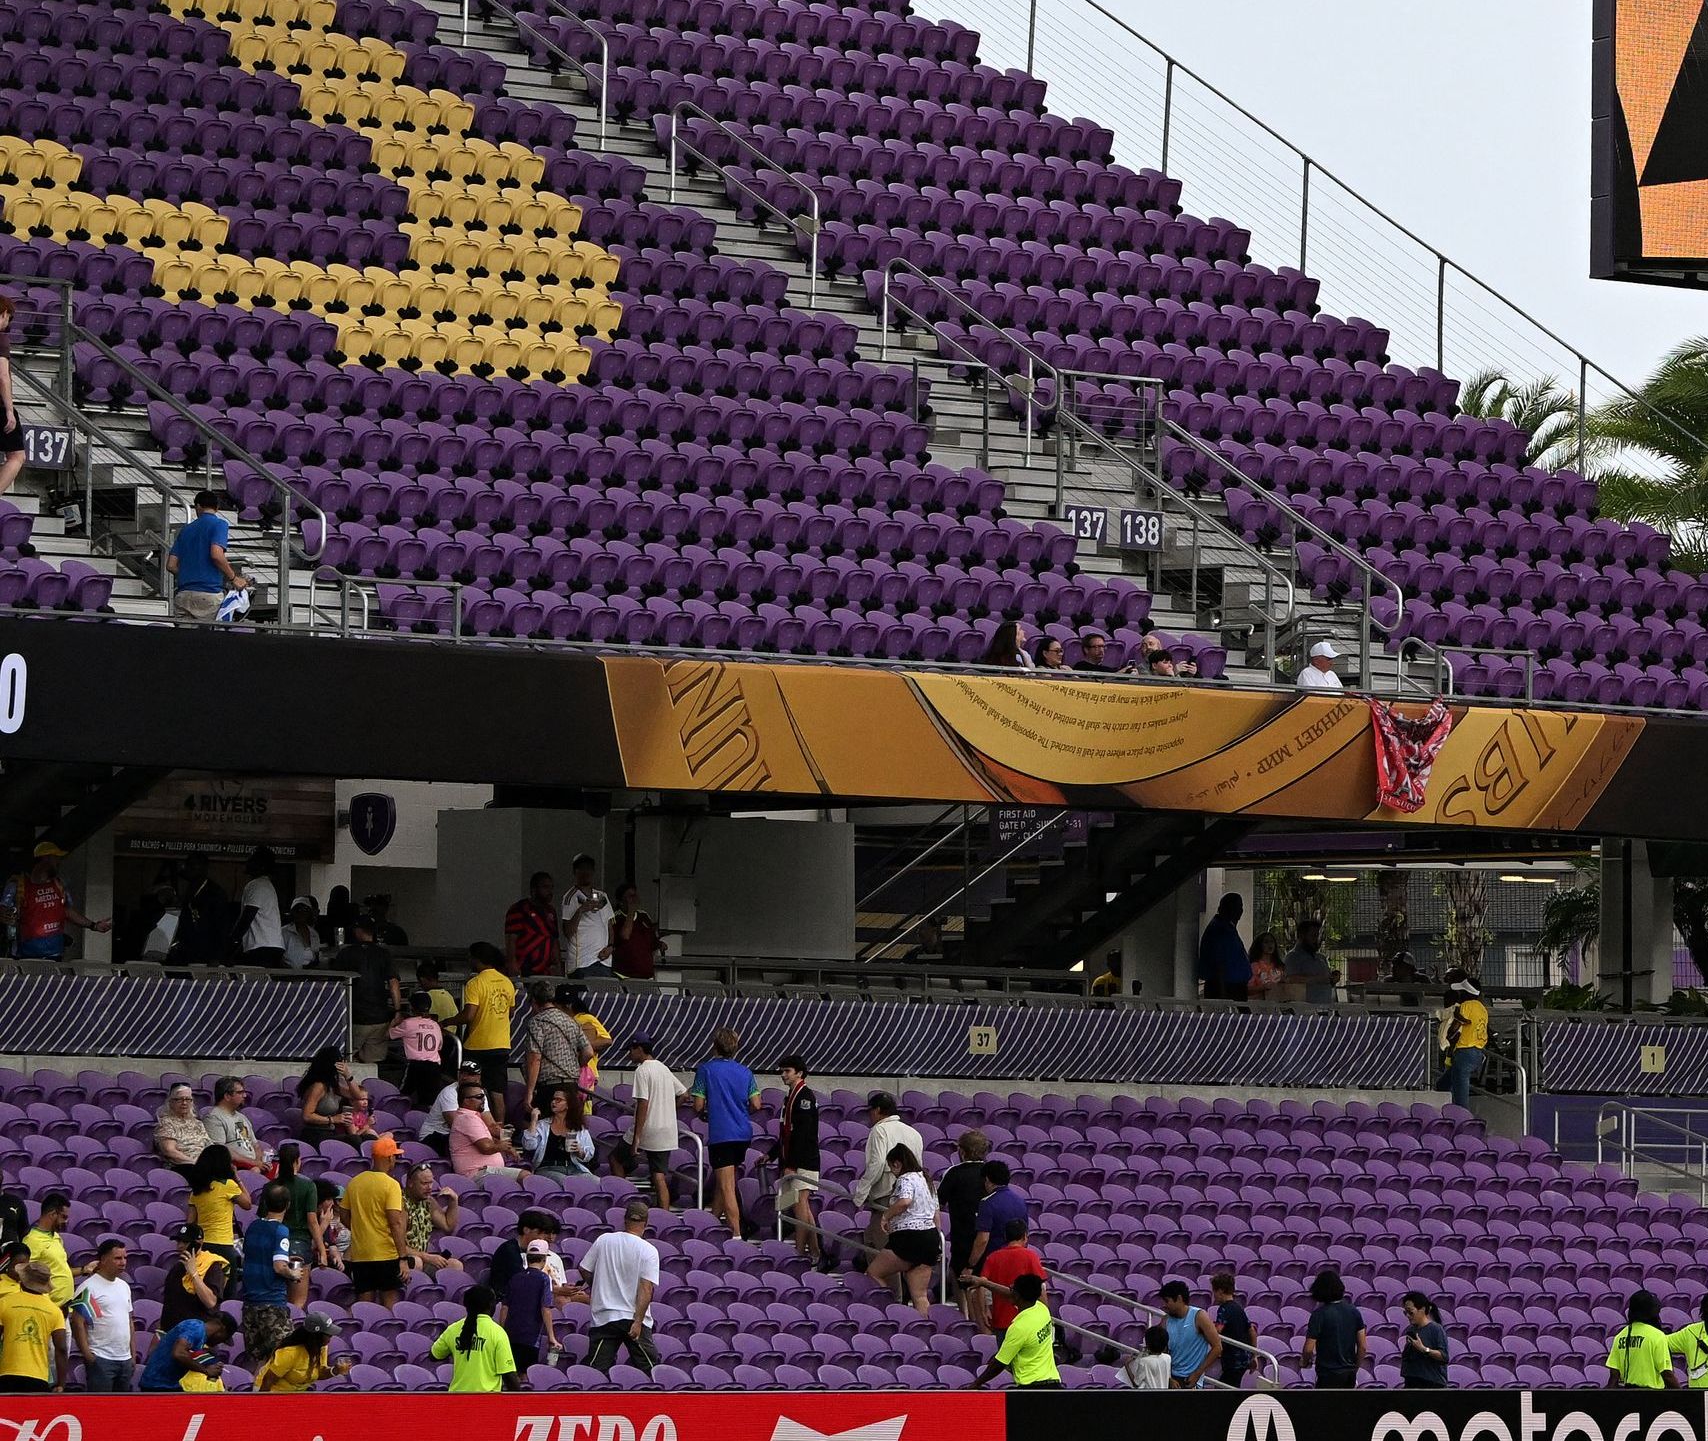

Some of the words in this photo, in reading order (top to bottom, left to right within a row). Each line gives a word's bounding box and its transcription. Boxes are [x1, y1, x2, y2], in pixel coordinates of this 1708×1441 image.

[25, 429, 69, 463] 137
[1068, 509, 1105, 540] 137
[1123, 514, 1160, 546] 138
[1256, 743, 1293, 775] МИР
[184, 794, 194, 810] 4
[200, 795, 268, 814] RIVERS
[999, 810, 1020, 819] FIRST
[1023, 809, 1036, 818] AID
[999, 821, 1018, 830] GATE
[416, 1032, 436, 1052] 10
[977, 1033, 991, 1048] 37
[1650, 1052, 1656, 1066] 1
